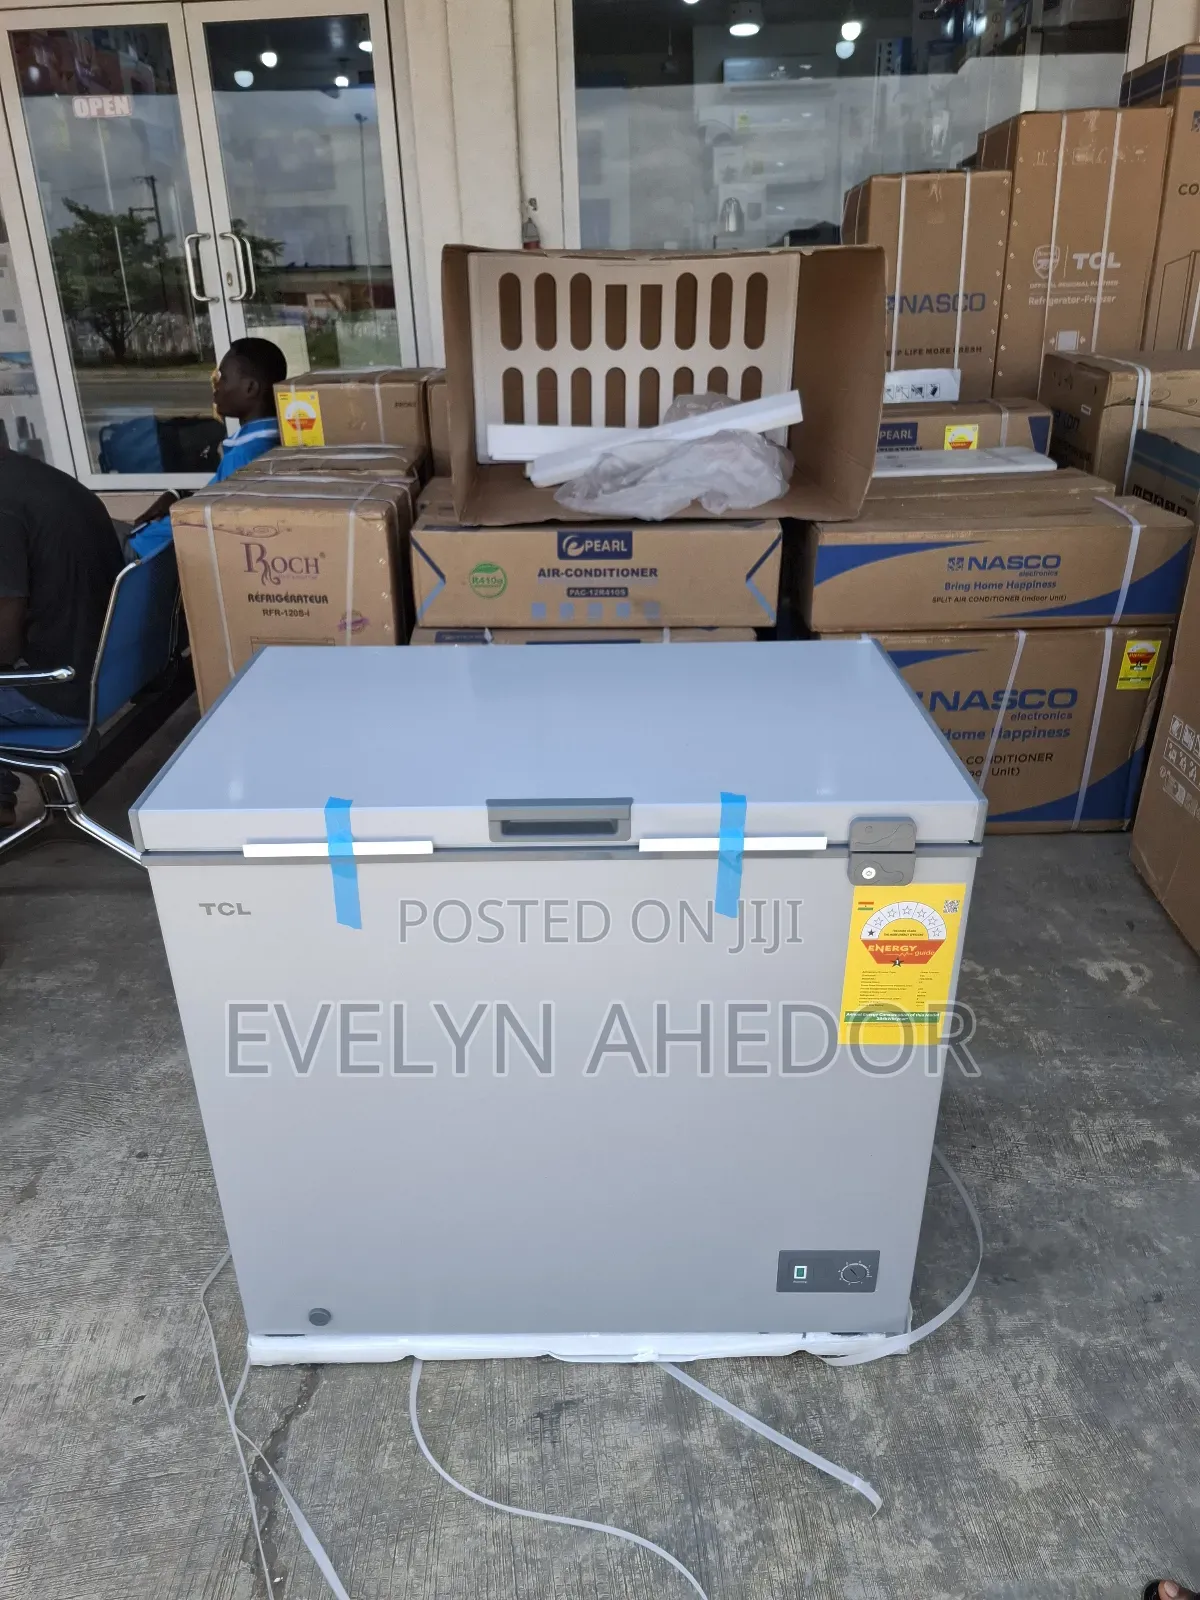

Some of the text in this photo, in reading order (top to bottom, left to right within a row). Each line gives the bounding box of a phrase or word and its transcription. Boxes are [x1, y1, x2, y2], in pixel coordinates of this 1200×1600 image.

[74, 96, 130, 118] OPEN
[1072, 252, 1121, 270] TCL
[898, 293, 985, 314] NASCO
[879, 429, 913, 440] PEARL
[584, 539, 628, 552] PEARL
[967, 555, 1062, 571] NASCO
[537, 568, 659, 578] AIR-CONDITIONER
[1018, 569, 1059, 578] electronics
[944, 579, 1057, 592] Bring Home Happiness
[932, 595, 952, 603] SPLIT
[953, 595, 967, 603] AIR
[968, 595, 1020, 603] CONDITIONER
[928, 687, 1079, 713] NASCO
[1010, 711, 1073, 721] electronics
[991, 766, 1021, 777] Unit)
[198, 902, 252, 916] TCL
[867, 943, 918, 954] ENERGY
[914, 949, 935, 957] guide
